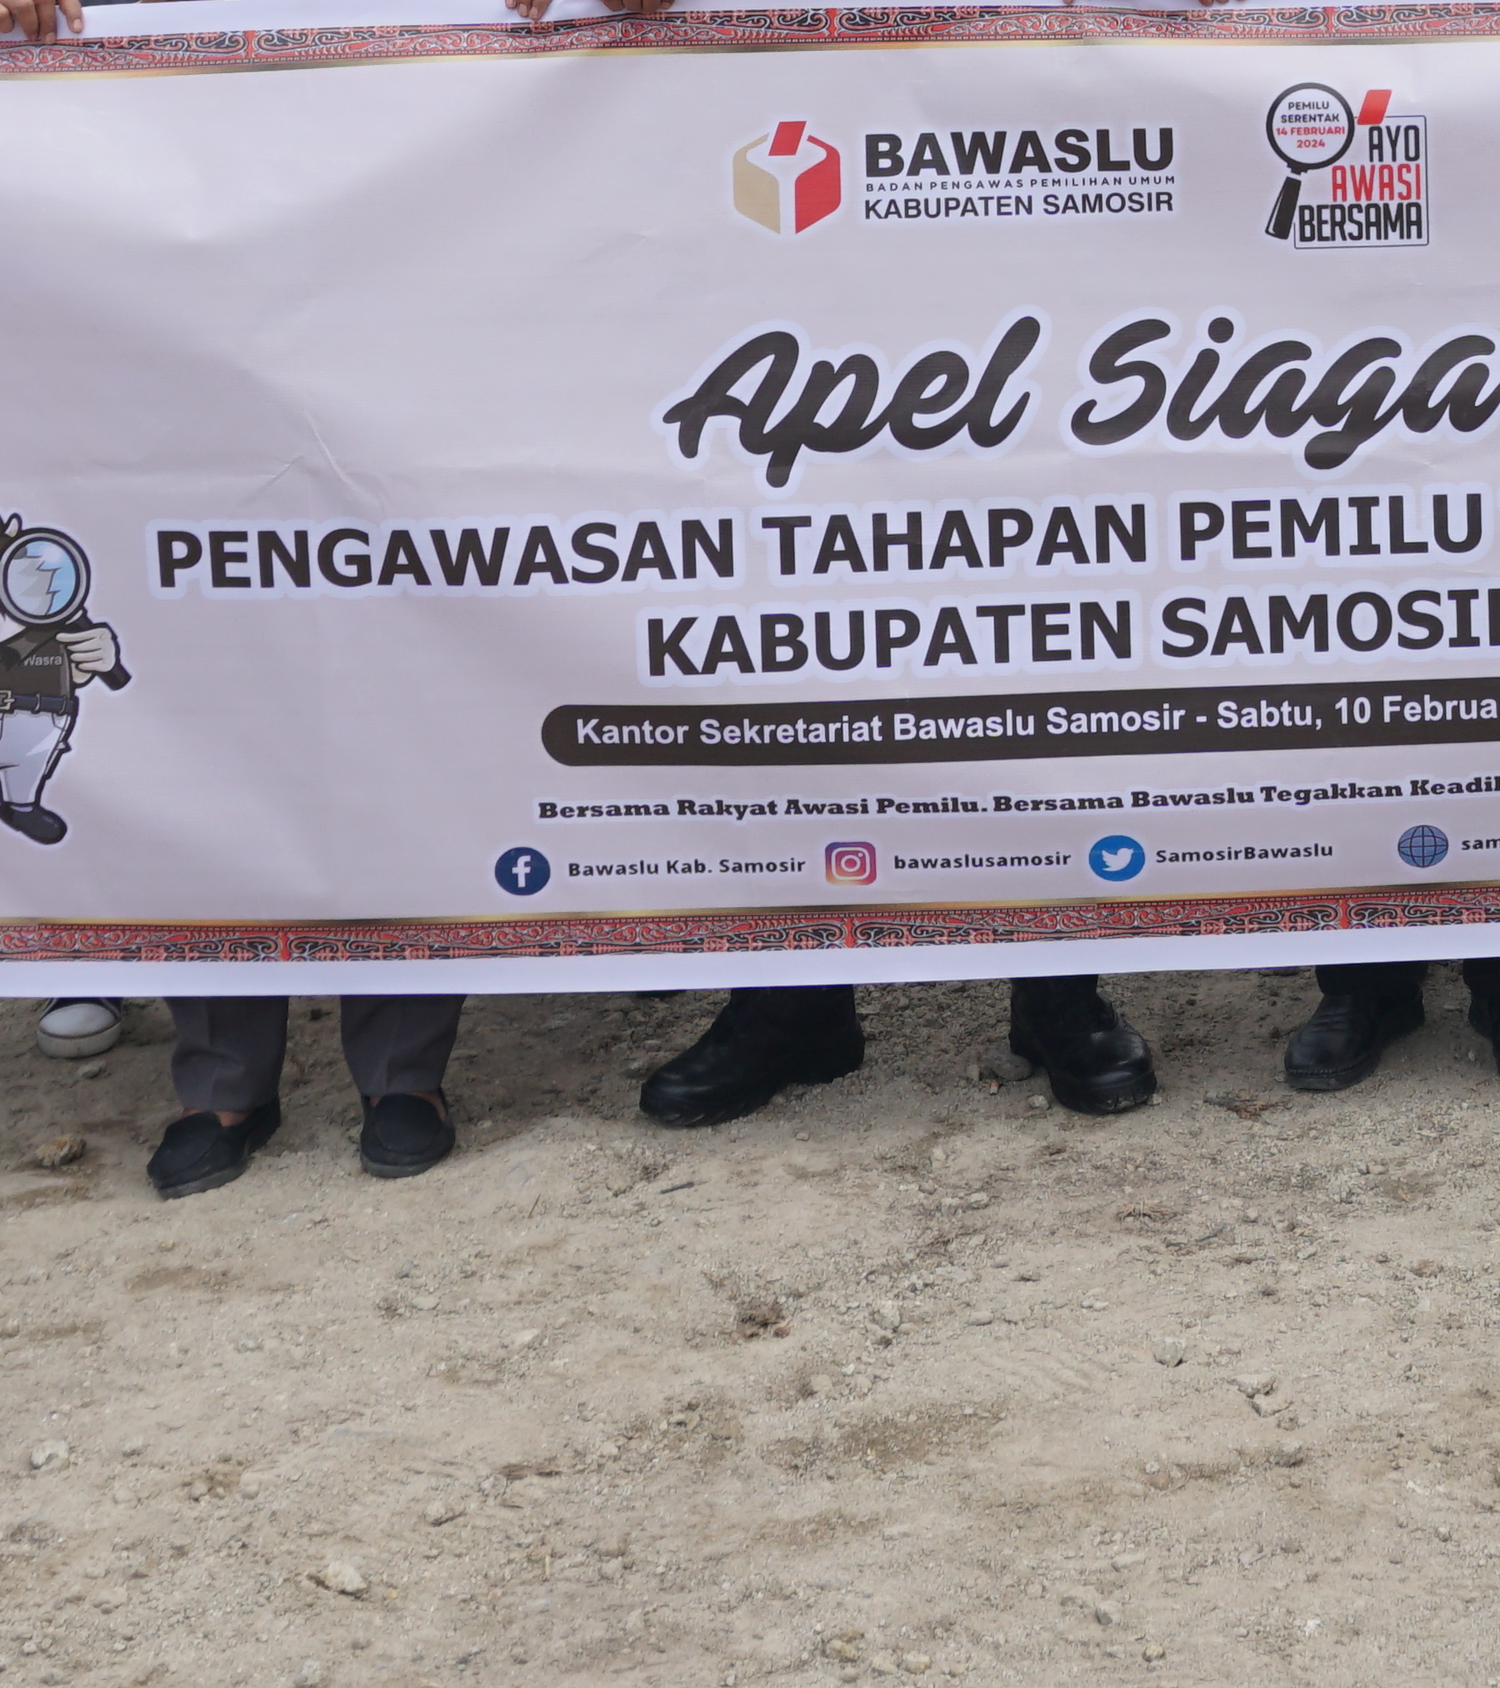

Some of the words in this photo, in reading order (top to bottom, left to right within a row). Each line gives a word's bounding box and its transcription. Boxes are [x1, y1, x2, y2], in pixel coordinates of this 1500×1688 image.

[1280, 114, 1340, 124] SERENTAK
[1288, 101, 1330, 110] PEMILU
[1276, 127, 1288, 136] 14
[1290, 126, 1345, 136] FEBRUARI
[1296, 140, 1326, 148] 2024
[1368, 125, 1420, 162] AYO
[865, 127, 1174, 177] BAWASLU
[866, 181, 923, 192] BADAN
[930, 179, 1024, 191] PENGAWAS
[1031, 177, 1122, 188] PEMILIHAN
[1130, 175, 1176, 186] UMUM
[1332, 164, 1421, 202] AWASI
[865, 196, 1033, 220] KABUPATEN
[1043, 192, 1174, 216] SAMOSIR
[1299, 202, 1423, 242] BERSAMA
[662, 315, 1041, 488] Apel
[156, 518, 735, 589] PENGAWASAN
[761, 505, 1146, 576] TAHAPAN
[1179, 493, 1484, 562] PEMILU
[648, 600, 1131, 677] KABUPATEN
[23, 653, 62, 667] Wasra
[576, 718, 688, 745] Kantor
[700, 715, 883, 745] Sekretariat
[893, 709, 1036, 742] Bawaslu
[1046, 703, 1185, 734] Samosir
[1216, 699, 1323, 731] Sabtu,
[1336, 697, 1371, 724] 10
[538, 799, 670, 819] Bersama
[677, 798, 778, 821] Rakyat
[784, 797, 870, 816] Awasi
[876, 795, 988, 815] Pemilu.
[994, 791, 1123, 812] Bersama
[1131, 787, 1254, 808] Bawaslu
[1260, 782, 1403, 806] Tegakkan
[568, 859, 660, 878] Bawaslu
[666, 858, 713, 876] Kab.
[718, 855, 806, 874] Samosir
[894, 850, 1072, 870] bawaslusamosir
[1155, 842, 1334, 863] SamosirBawaslu
